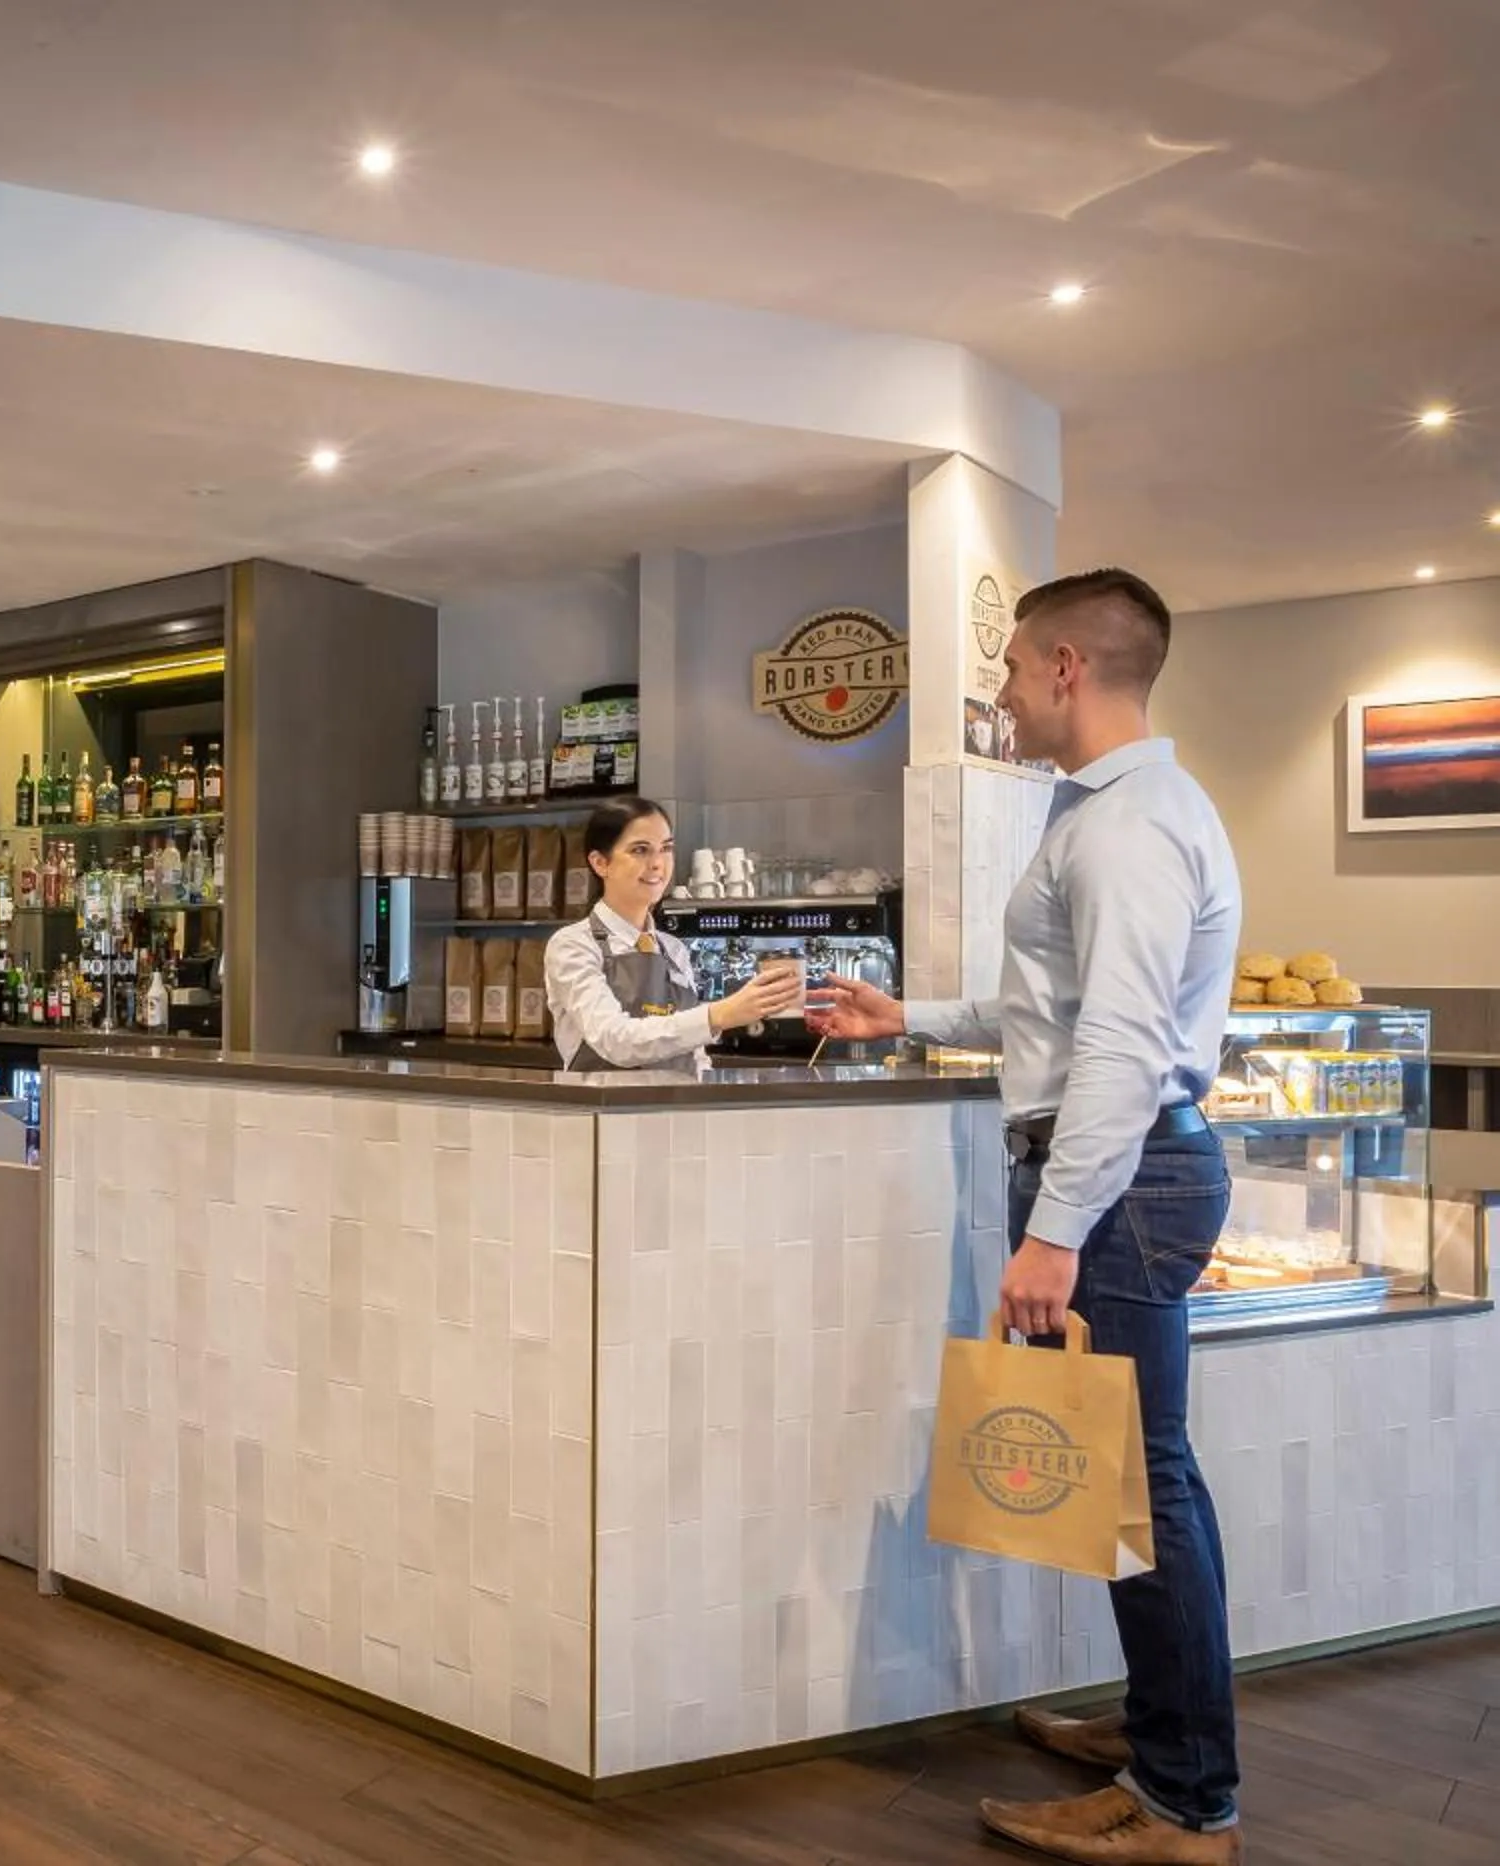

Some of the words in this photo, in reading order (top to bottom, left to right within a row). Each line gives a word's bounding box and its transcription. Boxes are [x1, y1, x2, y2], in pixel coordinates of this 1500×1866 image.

[800, 629, 826, 653] RED
[835, 624, 875, 644] BEAN
[793, 704, 825, 728] HAND
[831, 693, 884, 730] CRAFTED
[960, 1436, 1087, 1480] ROASTERY
